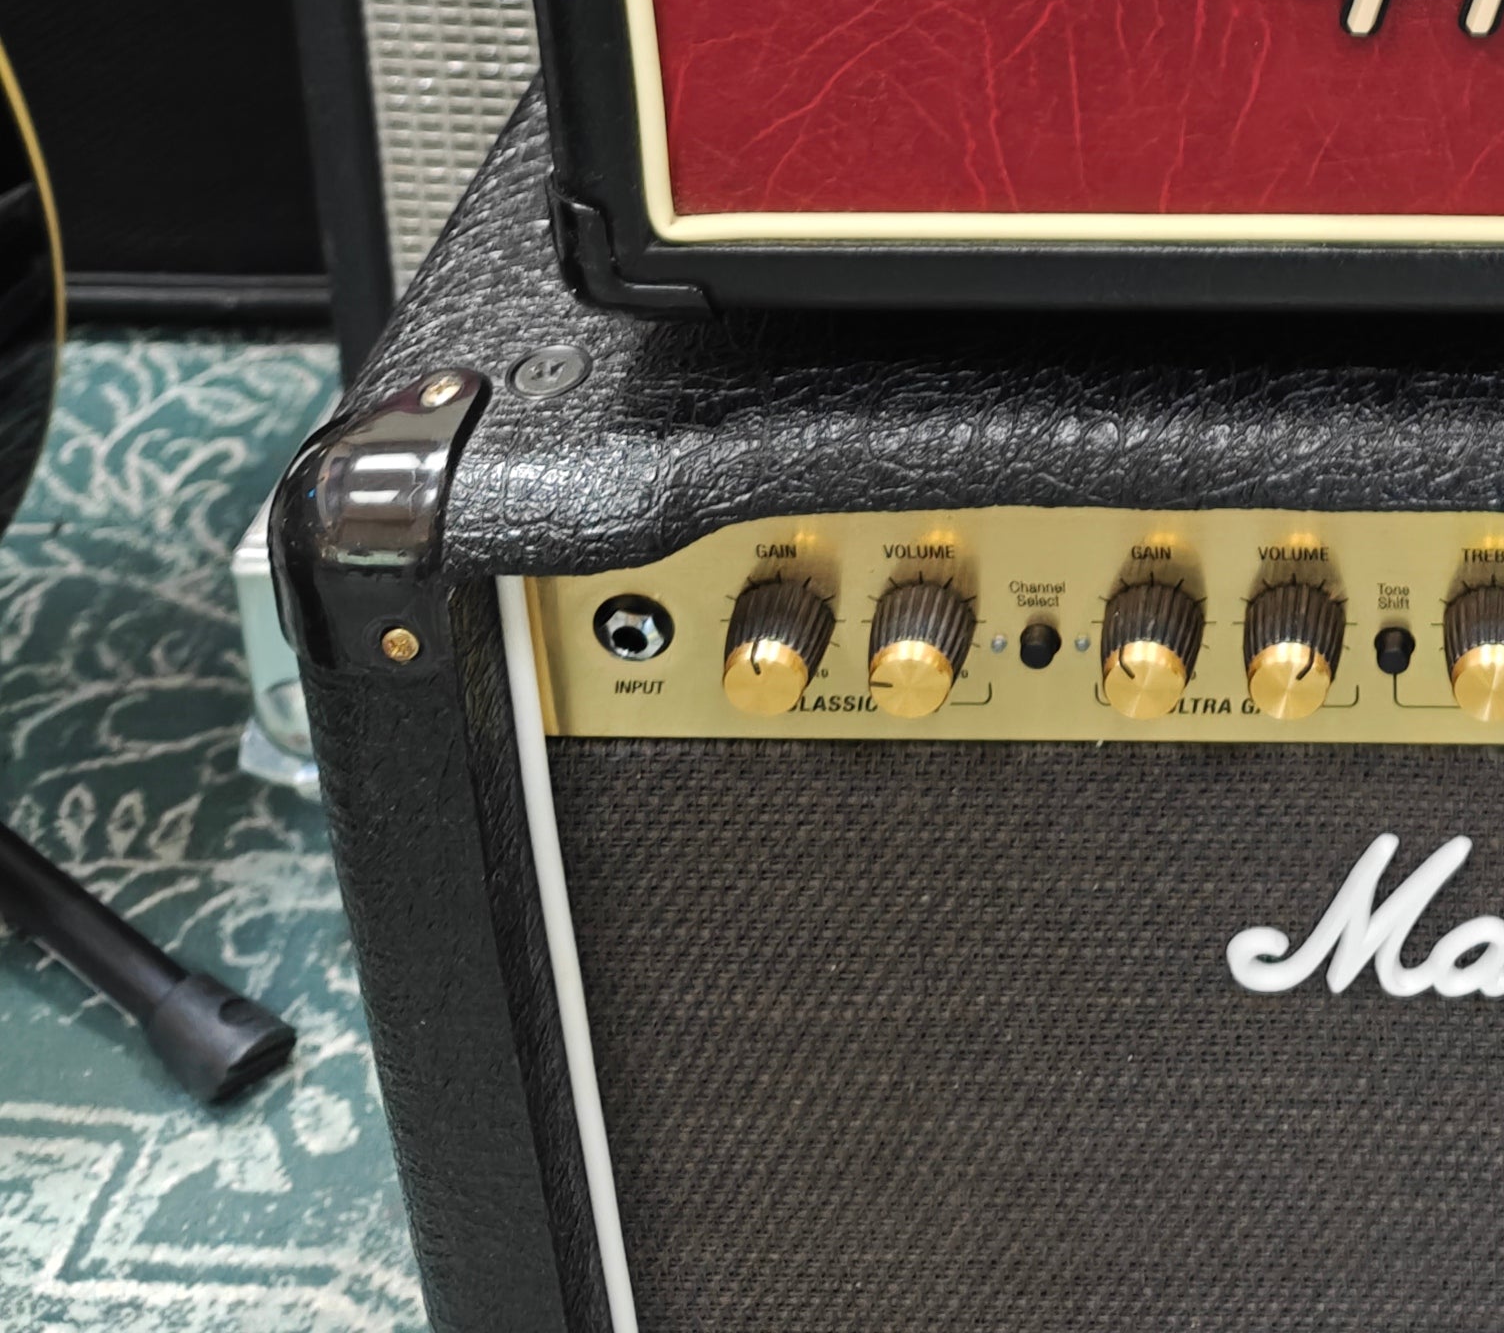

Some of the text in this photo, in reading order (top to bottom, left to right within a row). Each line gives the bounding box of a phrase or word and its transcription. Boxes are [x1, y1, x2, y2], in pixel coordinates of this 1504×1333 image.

[755, 543, 798, 560] GAIN
[882, 543, 955, 560] VOLUME
[1130, 545, 1172, 561] GAIN
[1257, 546, 1330, 562] VOLUME
[1009, 580, 1066, 594] Channel
[1377, 582, 1410, 596] Tone
[1017, 594, 1060, 608] Select
[1378, 596, 1410, 610] Shift
[614, 679, 665, 695] INPUT
[1167, 697, 1232, 715] LTRA
